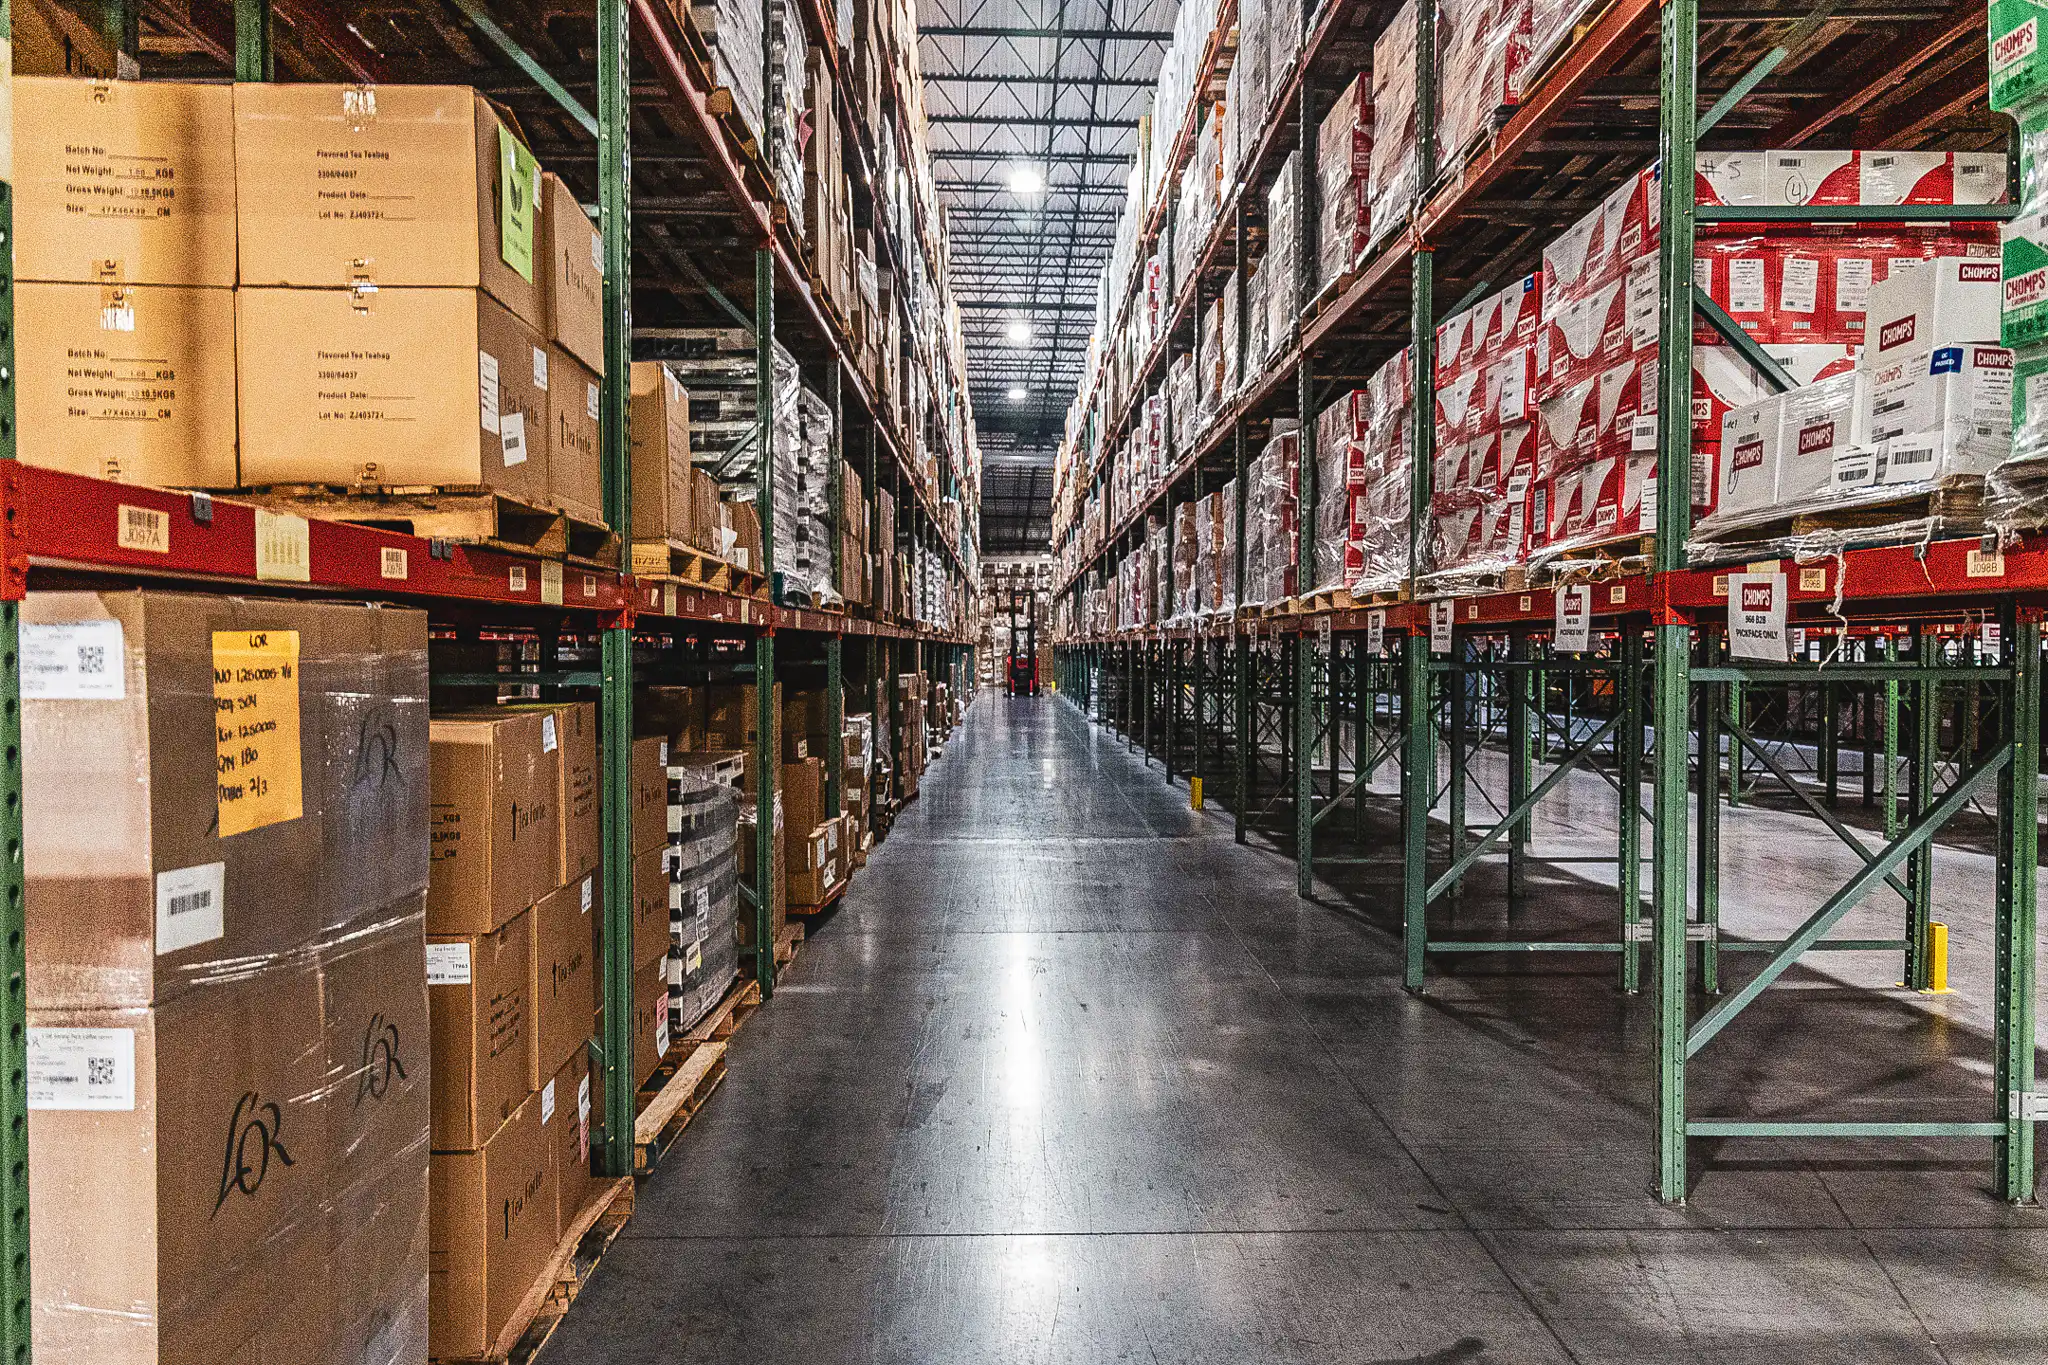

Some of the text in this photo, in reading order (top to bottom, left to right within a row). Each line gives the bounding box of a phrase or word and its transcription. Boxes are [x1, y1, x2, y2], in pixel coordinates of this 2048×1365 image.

[1994, 23, 2033, 62] CHOMPS
[316, 149, 390, 160] Flavored Tea Teabag
[65, 164, 80, 176] Net
[155, 167, 175, 179] KGS
[66, 183, 92, 195] Gross
[318, 190, 347, 199] Product
[156, 207, 171, 217] CM
[318, 210, 331, 220] Lot
[1962, 266, 1998, 280] CHOMPS
[2006, 271, 2046, 301] CHOMPS
[1882, 320, 1913, 346] CHOMPS
[67, 347, 92, 359] Batch
[317, 350, 391, 361] Flavored Tea Teabag
[1977, 352, 2014, 366] CHOMPS
[67, 367, 82, 378] Net
[156, 369, 175, 380] KGS
[67, 387, 93, 398] Gross
[318, 391, 347, 400] Product
[157, 408, 172, 419] CM
[318, 411, 331, 420] Lot
[1801, 426, 1832, 450] CHOMPS
[1735, 445, 1761, 466] CHOMPS
[124, 527, 161, 548] J097A
[1971, 562, 1998, 574] J098B
[1743, 588, 1771, 607] CHOMPS
[1735, 628, 1779, 640] PICKFACE ONLY
[249, 633, 268, 649] LOR
[249, 775, 268, 798] 2/3
[443, 813, 461, 823] KGS
[444, 849, 457, 858] CM
